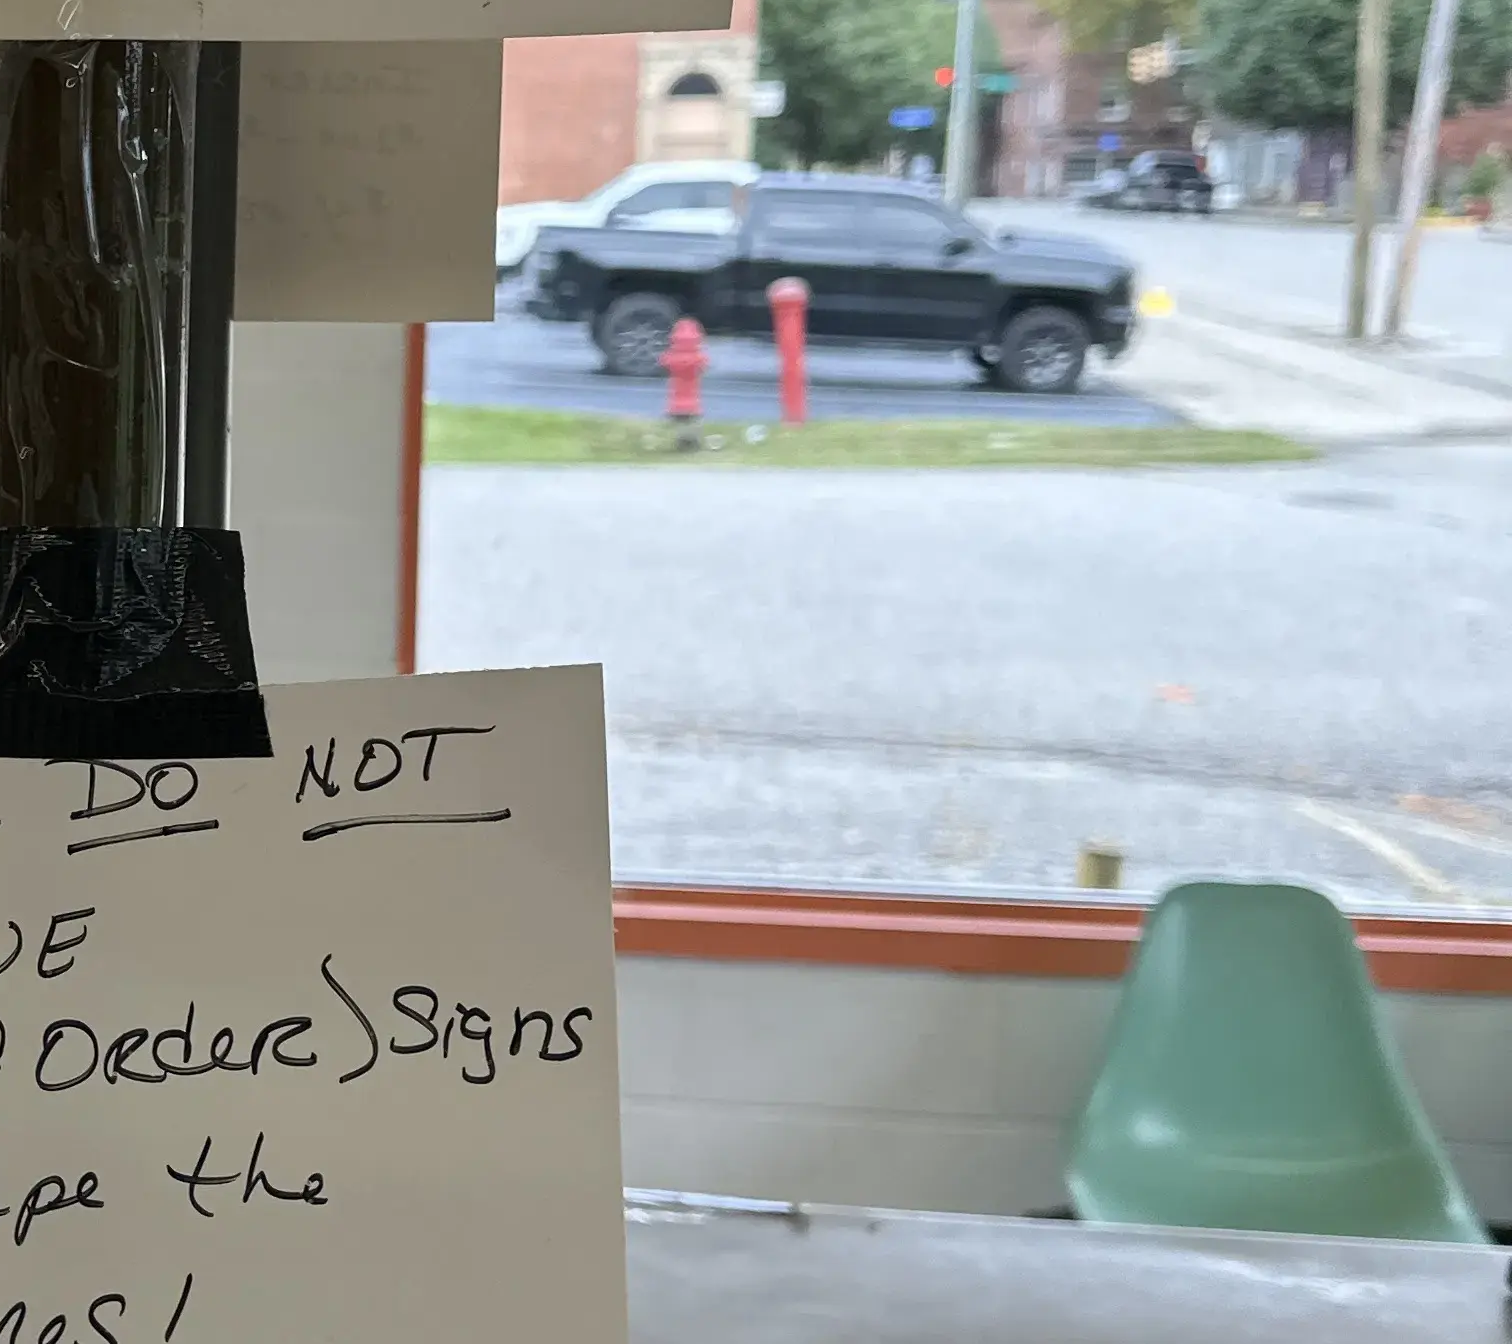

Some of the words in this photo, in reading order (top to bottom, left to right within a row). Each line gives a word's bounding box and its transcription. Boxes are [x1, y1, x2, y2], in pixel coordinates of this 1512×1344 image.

[45, 757, 199, 821] DO
[295, 724, 497, 804] NOT
[166, 1131, 329, 1218] the
